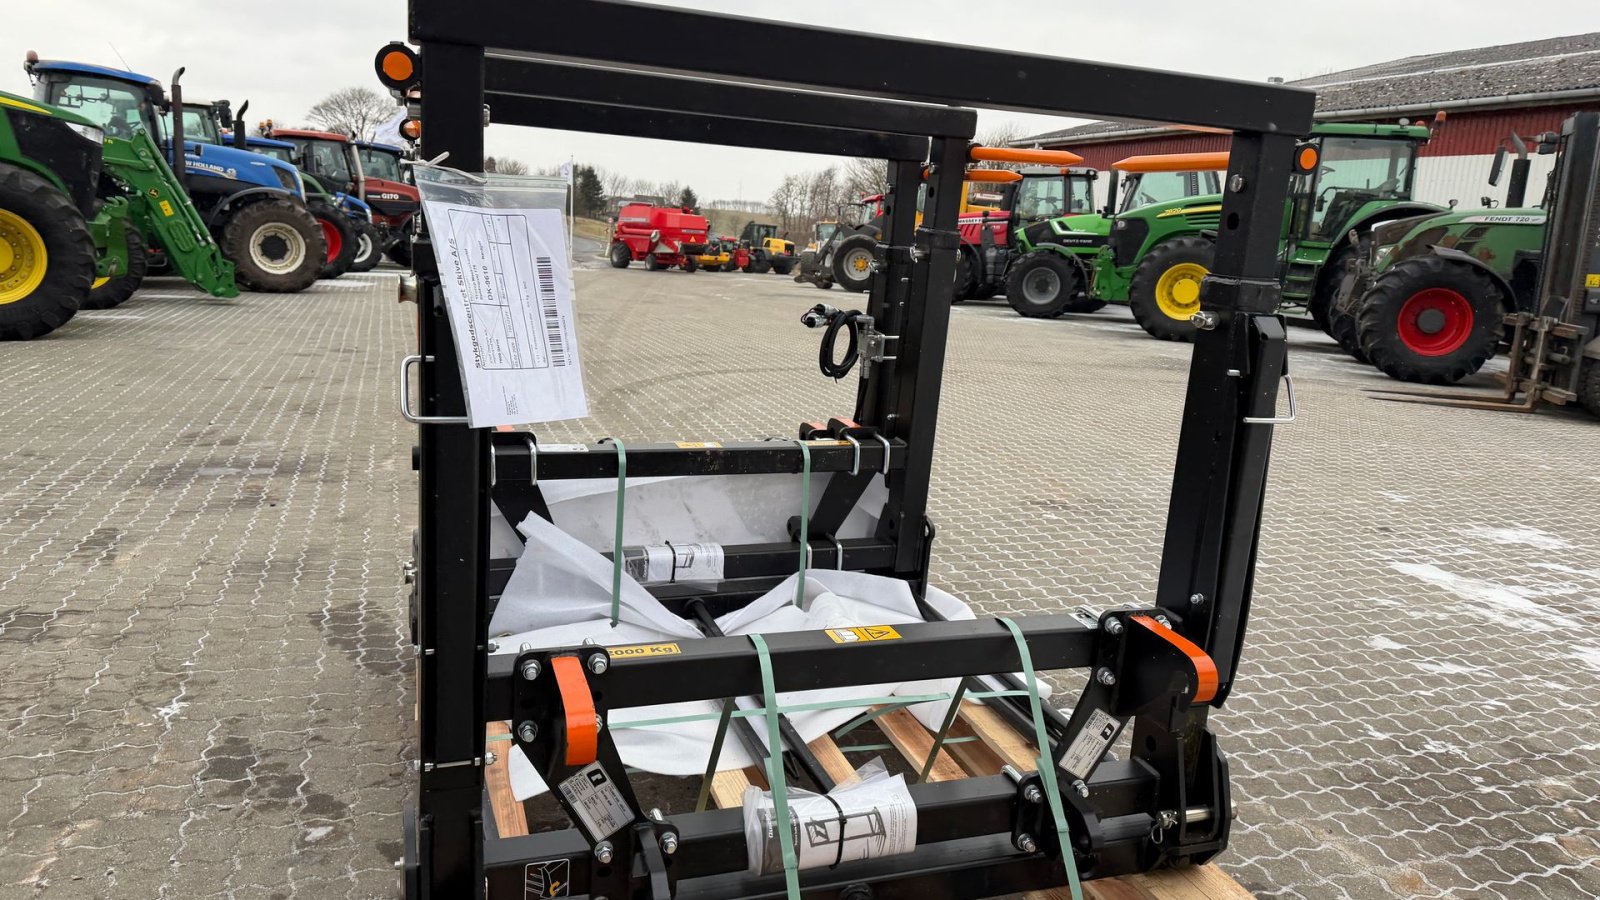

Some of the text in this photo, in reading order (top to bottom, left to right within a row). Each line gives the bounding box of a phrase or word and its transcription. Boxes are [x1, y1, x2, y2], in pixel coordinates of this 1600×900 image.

[192, 160, 225, 173] HOLLAND
[448, 238, 458, 258] A/S
[454, 260, 465, 286] Skive
[482, 265, 494, 301] DK-9610
[461, 289, 481, 369] Stykgodscentret
